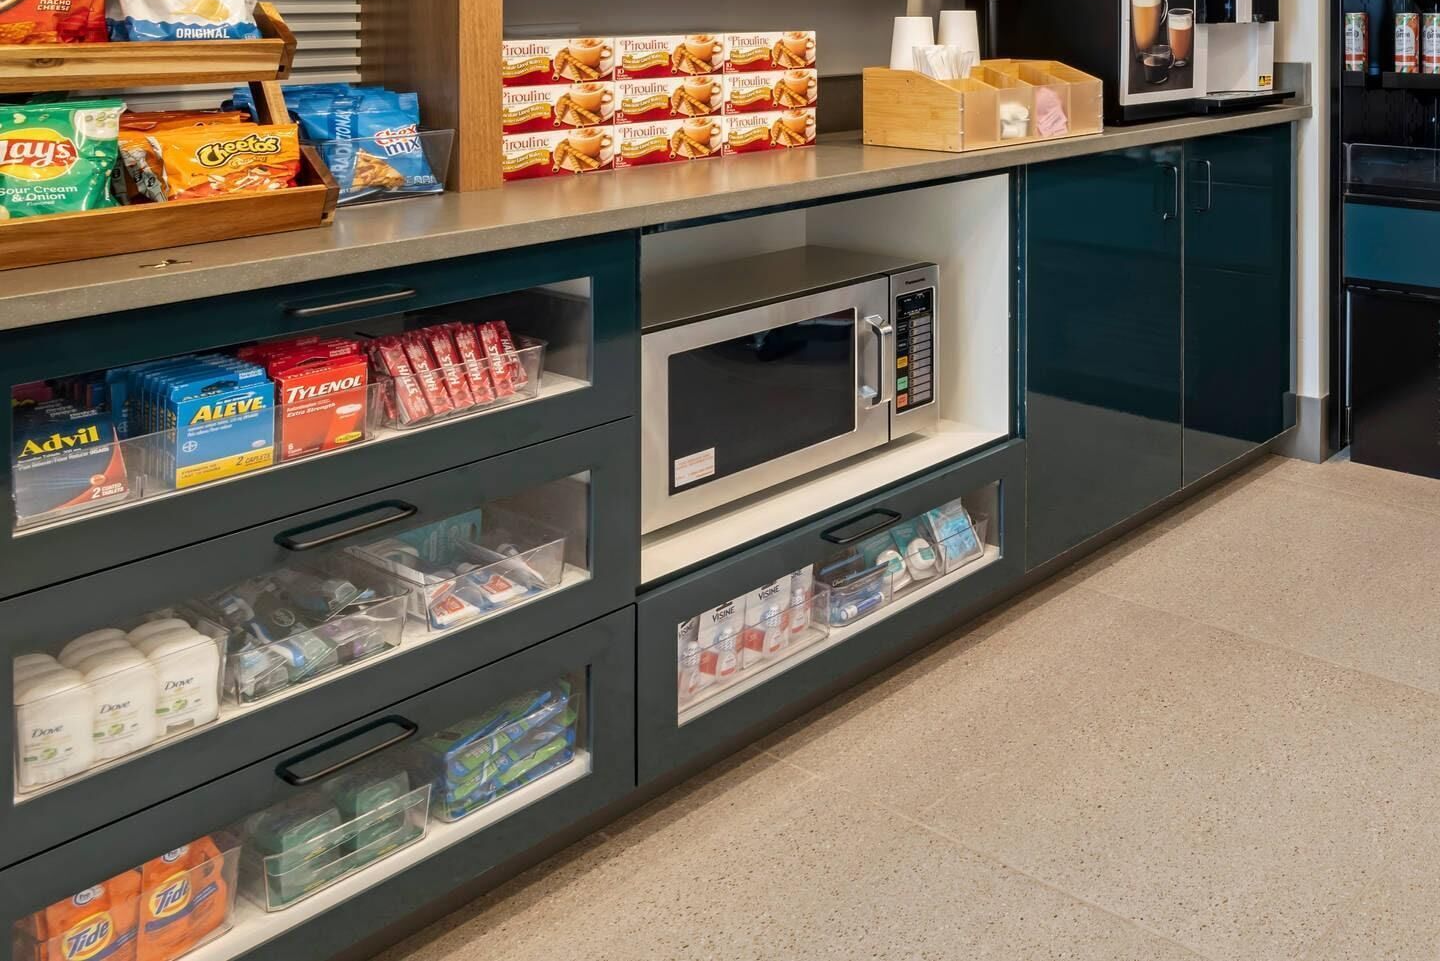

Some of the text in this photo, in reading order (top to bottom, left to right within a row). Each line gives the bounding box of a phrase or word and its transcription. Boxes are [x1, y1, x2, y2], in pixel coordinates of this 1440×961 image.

[176, 28, 230, 39] ORIGINAL
[624, 40, 668, 50] Pirouline
[731, 36, 768, 46] Pirouline
[624, 83, 668, 94] Pirouline
[732, 76, 769, 87] Pirouline
[729, 116, 768, 127] Pirouline
[623, 126, 667, 138] Pirouline
[198, 136, 280, 167] Cheetos
[34, 185, 78, 194] Cream
[465, 351, 482, 381] HALLS
[488, 344, 504, 374] HALLS
[417, 360, 437, 391] HALLS
[441, 353, 460, 385] HALLS
[287, 375, 362, 404] TYLENOL
[190, 396, 264, 425] ALEVE
[287, 403, 335, 418] Extra Strength
[17, 425, 100, 458] Advil
[236, 456, 244, 466] 2
[92, 487, 101, 498] 2
[758, 585, 780, 600] VISINE
[712, 606, 735, 622] VISINE
[165, 677, 194, 690] Dove
[100, 701, 130, 714] Dove
[32, 725, 64, 738] Dove
[156, 880, 190, 915] Tide
[67, 921, 111, 958] Tide
